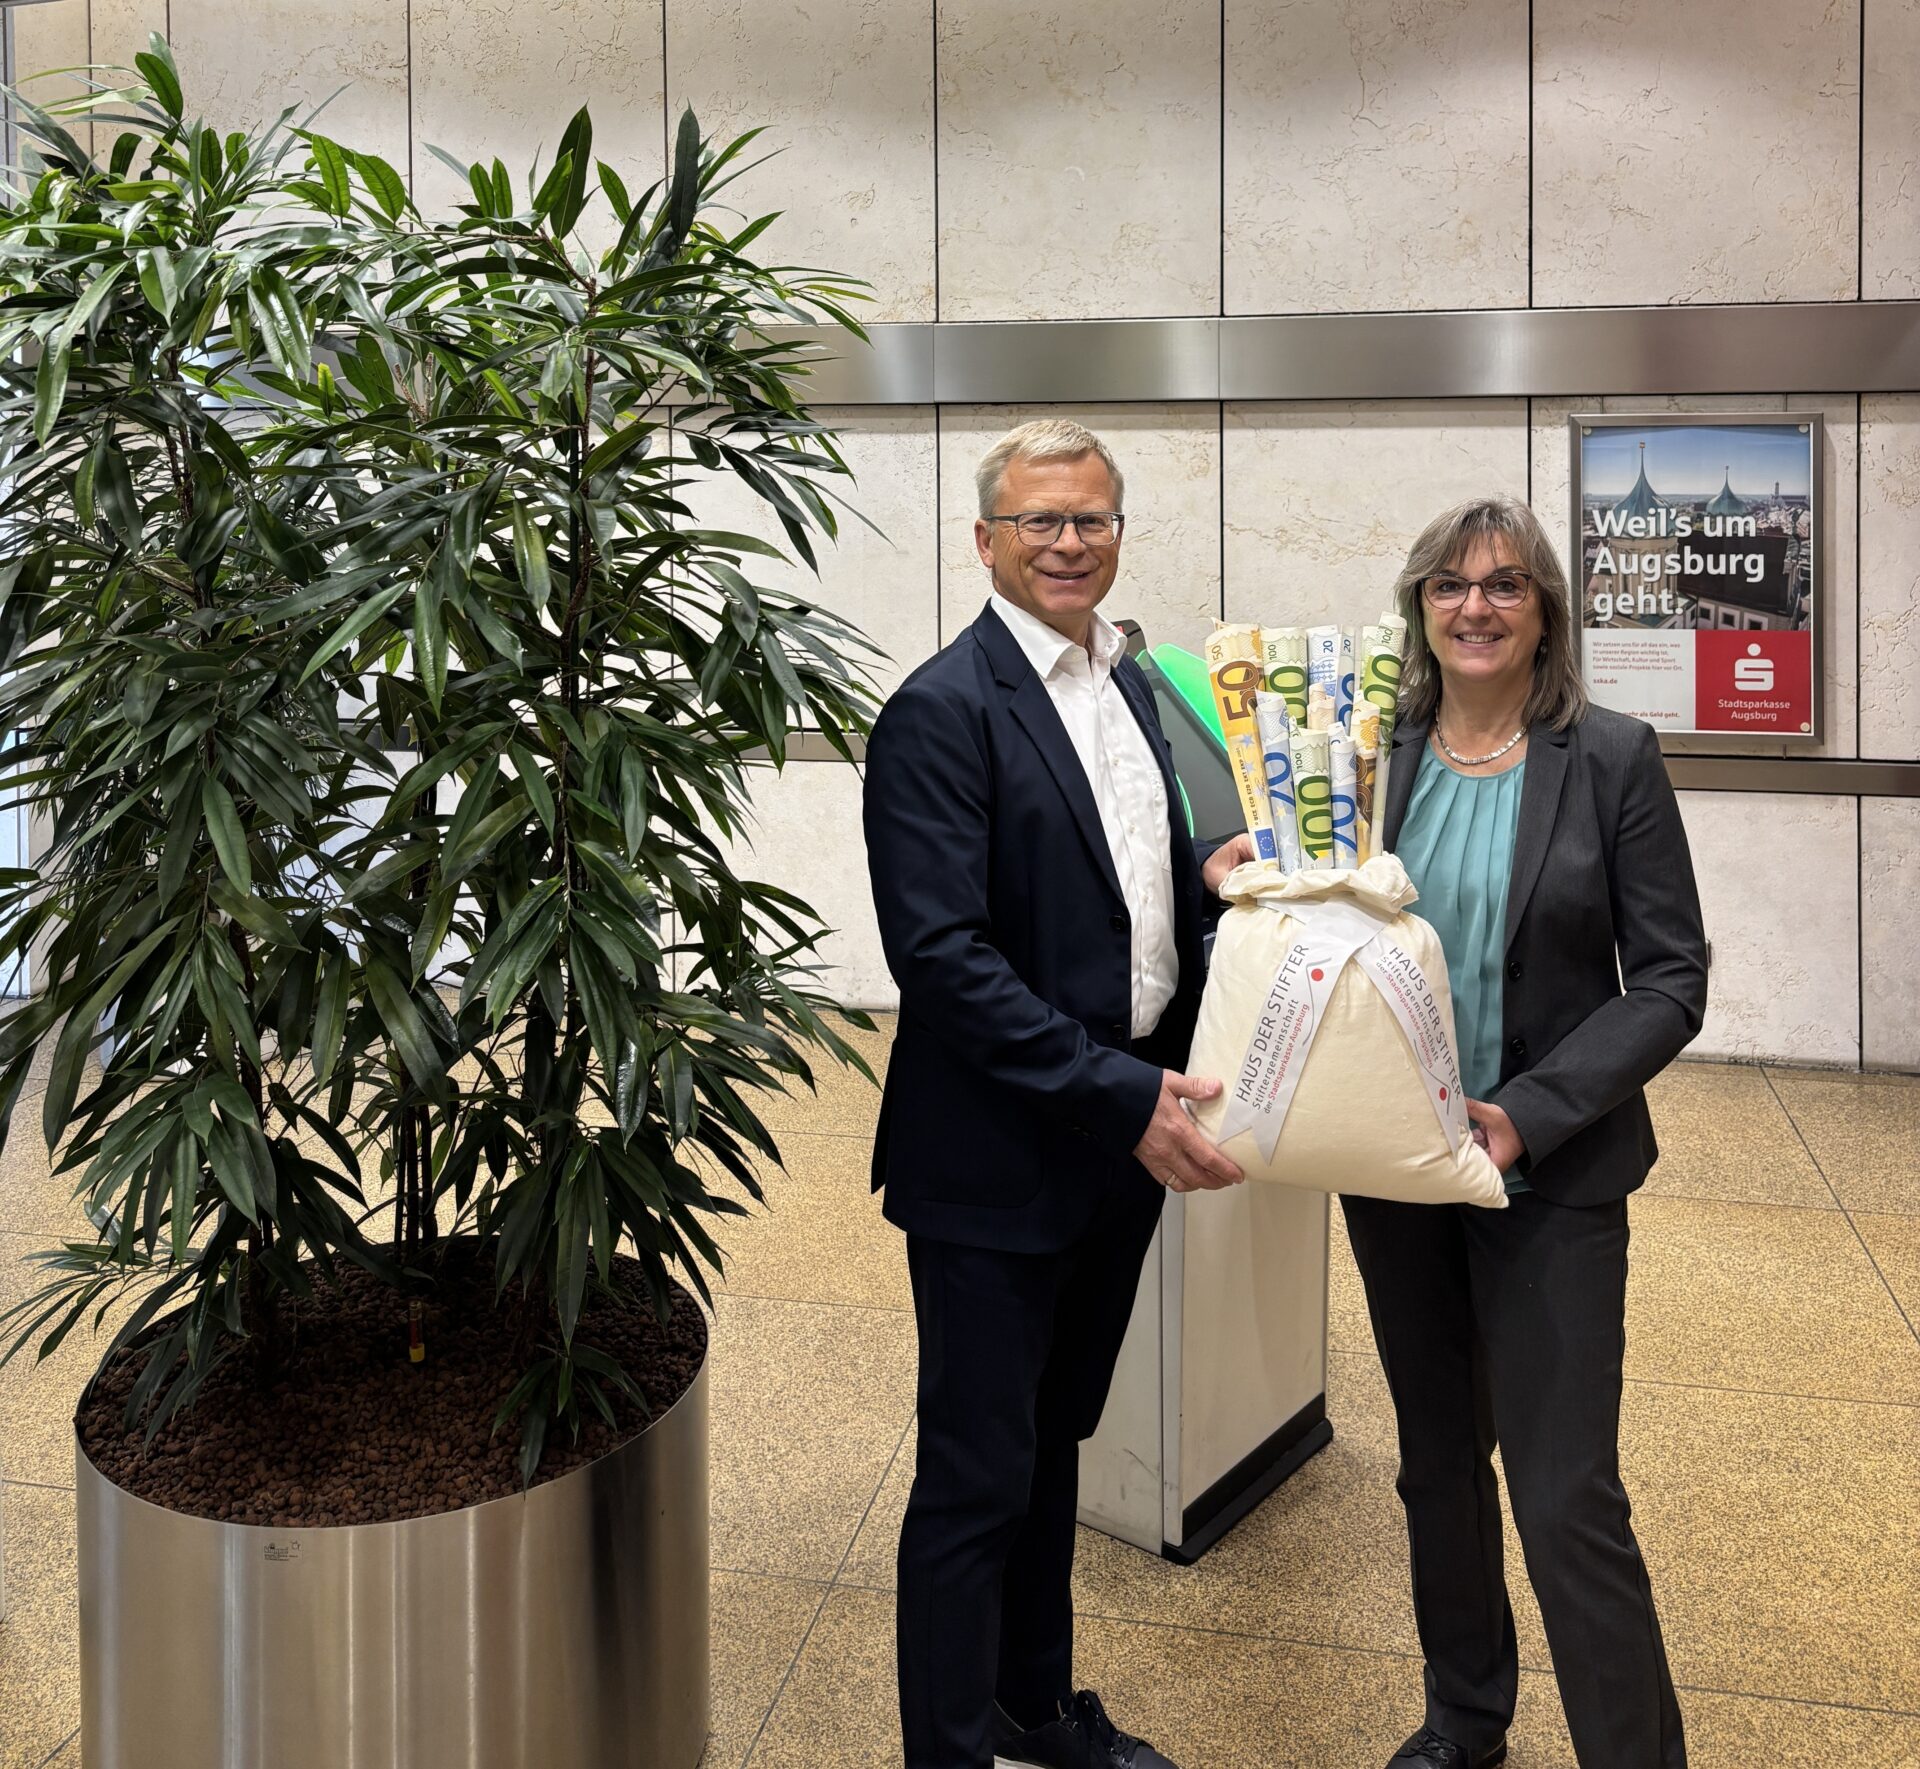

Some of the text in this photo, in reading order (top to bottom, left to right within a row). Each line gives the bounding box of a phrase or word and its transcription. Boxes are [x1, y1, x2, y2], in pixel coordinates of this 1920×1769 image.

[1592, 507, 1756, 538] Weil’s um
[1592, 545, 1766, 583] Augsburg
[1593, 585, 1684, 622] geht.
[1211, 645, 1224, 661] 50
[1267, 644, 1278, 660] 100
[1323, 639, 1334, 653] 20
[1343, 638, 1352, 653] 20
[1216, 660, 1260, 720] 50
[1717, 698, 1791, 710] Stadtsparkasse
[1730, 710, 1777, 722] Augsburg
[1297, 775, 1334, 861] 100
[1235, 944, 1309, 1103] HAUS DER STIFTER
[1376, 962, 1434, 1070] der Stadtsparkasse Augsburg
[1380, 955, 1439, 1062] Stiftergemeinschaft
[1389, 946, 1461, 1100] HAUS DER STIFTER
[1252, 999, 1299, 1111] Stiftergemeinschaft
[1263, 1003, 1310, 1114] der Stadtsparkasse Augsburg
